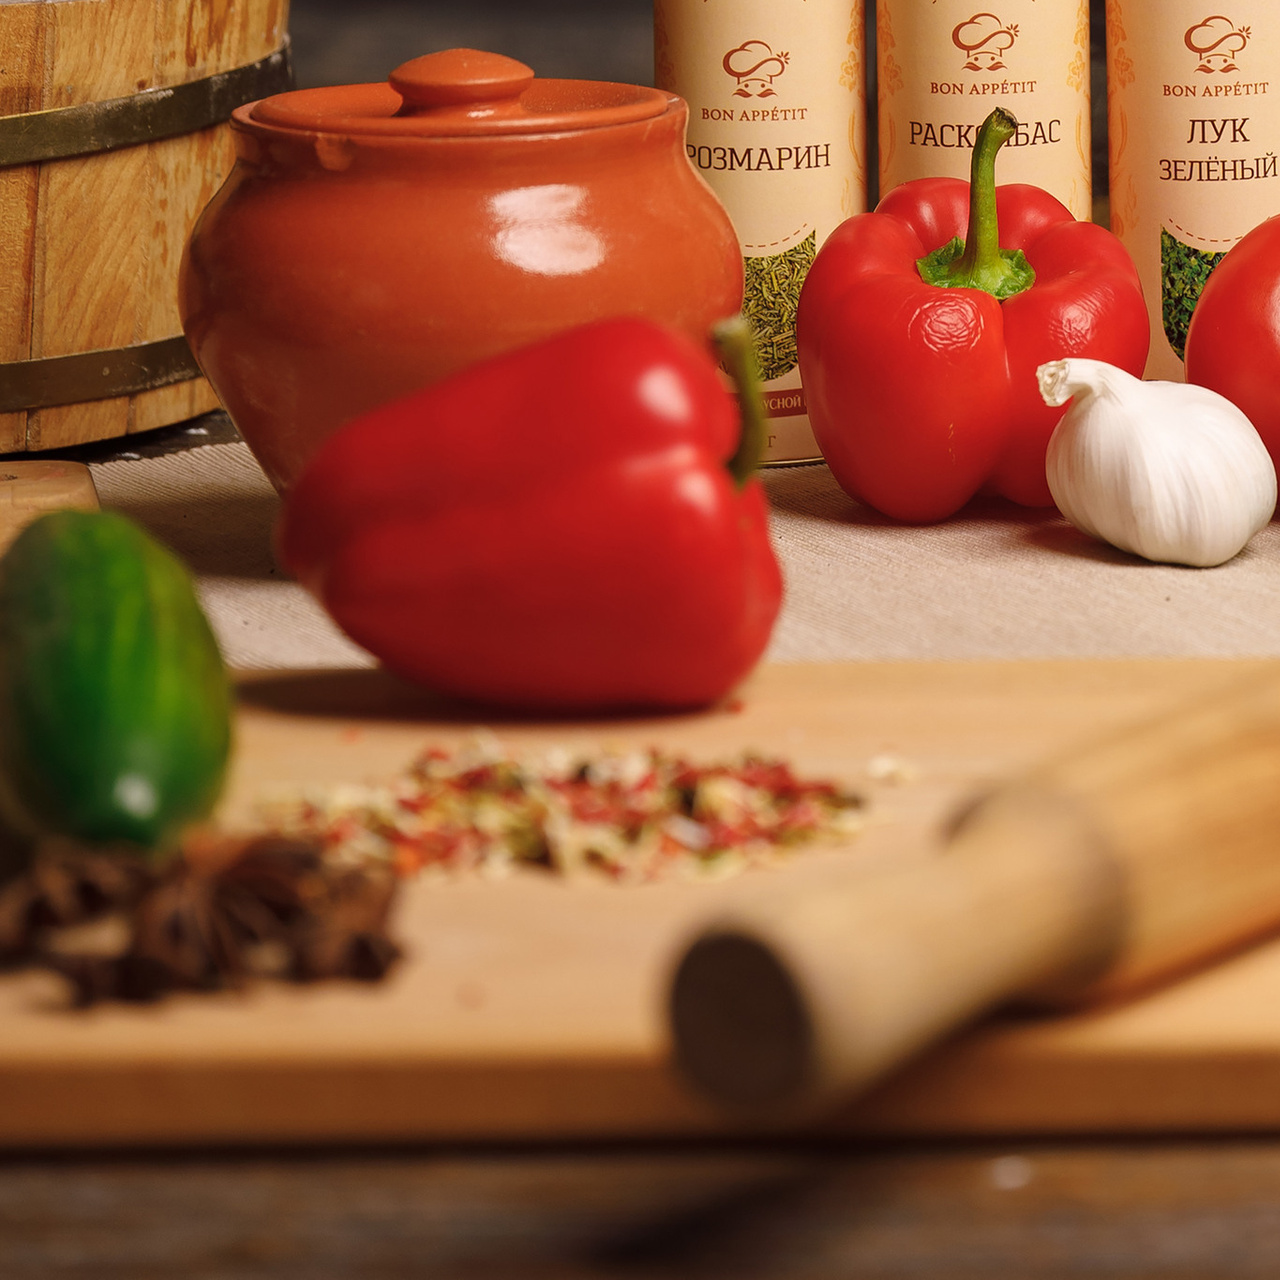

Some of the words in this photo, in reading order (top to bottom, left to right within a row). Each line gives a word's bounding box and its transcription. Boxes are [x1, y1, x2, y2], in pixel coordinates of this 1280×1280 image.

[930, 81, 964, 95] BON
[968, 79, 1037, 95] APPÉTIT
[1162, 84, 1197, 97] BON
[1201, 81, 1270, 97] APPÉTIT
[701, 107, 735, 121] BON
[739, 106, 808, 122] APPÉTIT
[909, 119, 1061, 148] РАСКБАС
[1186, 117, 1251, 144] ЛУК
[686, 143, 831, 171] РОЗМАРИН
[1158, 151, 1279, 182] ЗЕЛЁНЫЙ
